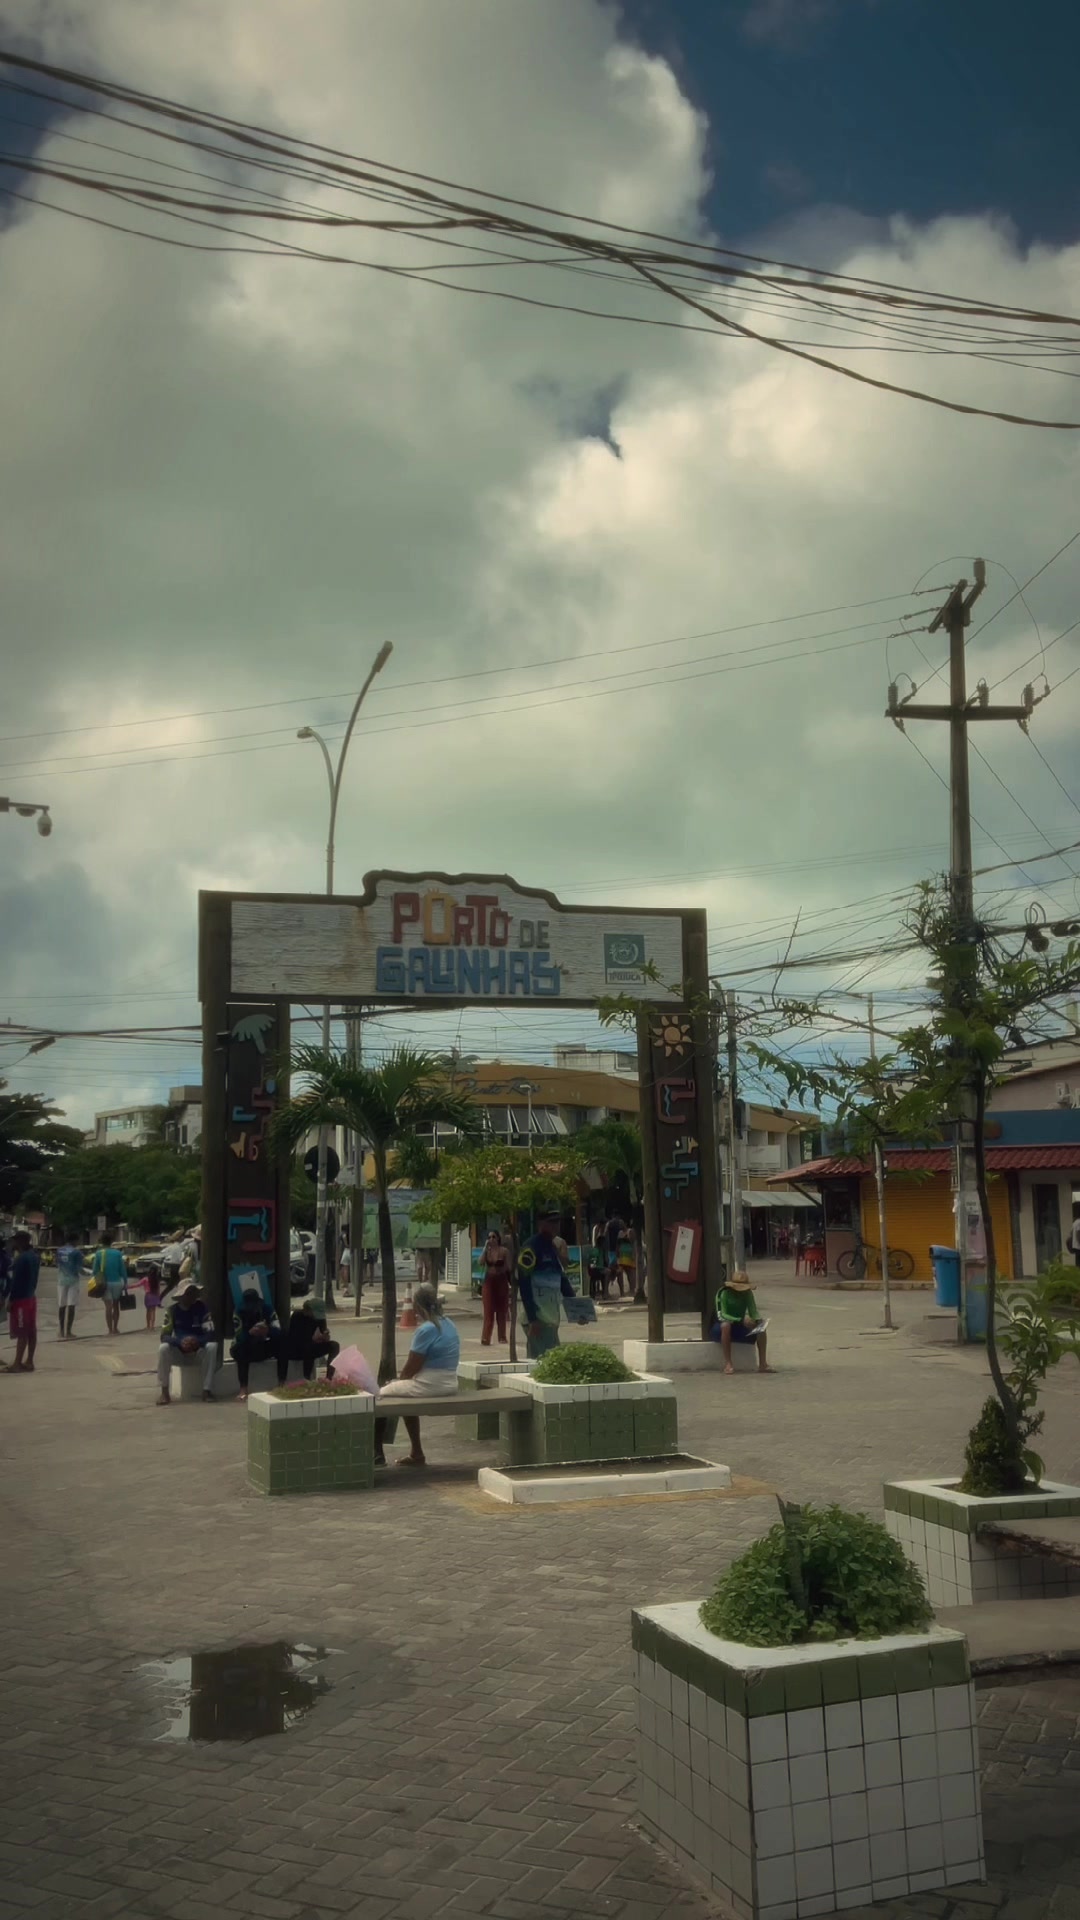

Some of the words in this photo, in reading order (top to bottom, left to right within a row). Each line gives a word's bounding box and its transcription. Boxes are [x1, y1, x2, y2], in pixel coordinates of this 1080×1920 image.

[393, 889, 513, 946] PORTO
[519, 919, 550, 948] DE
[376, 946, 560, 995] GALINHAS
